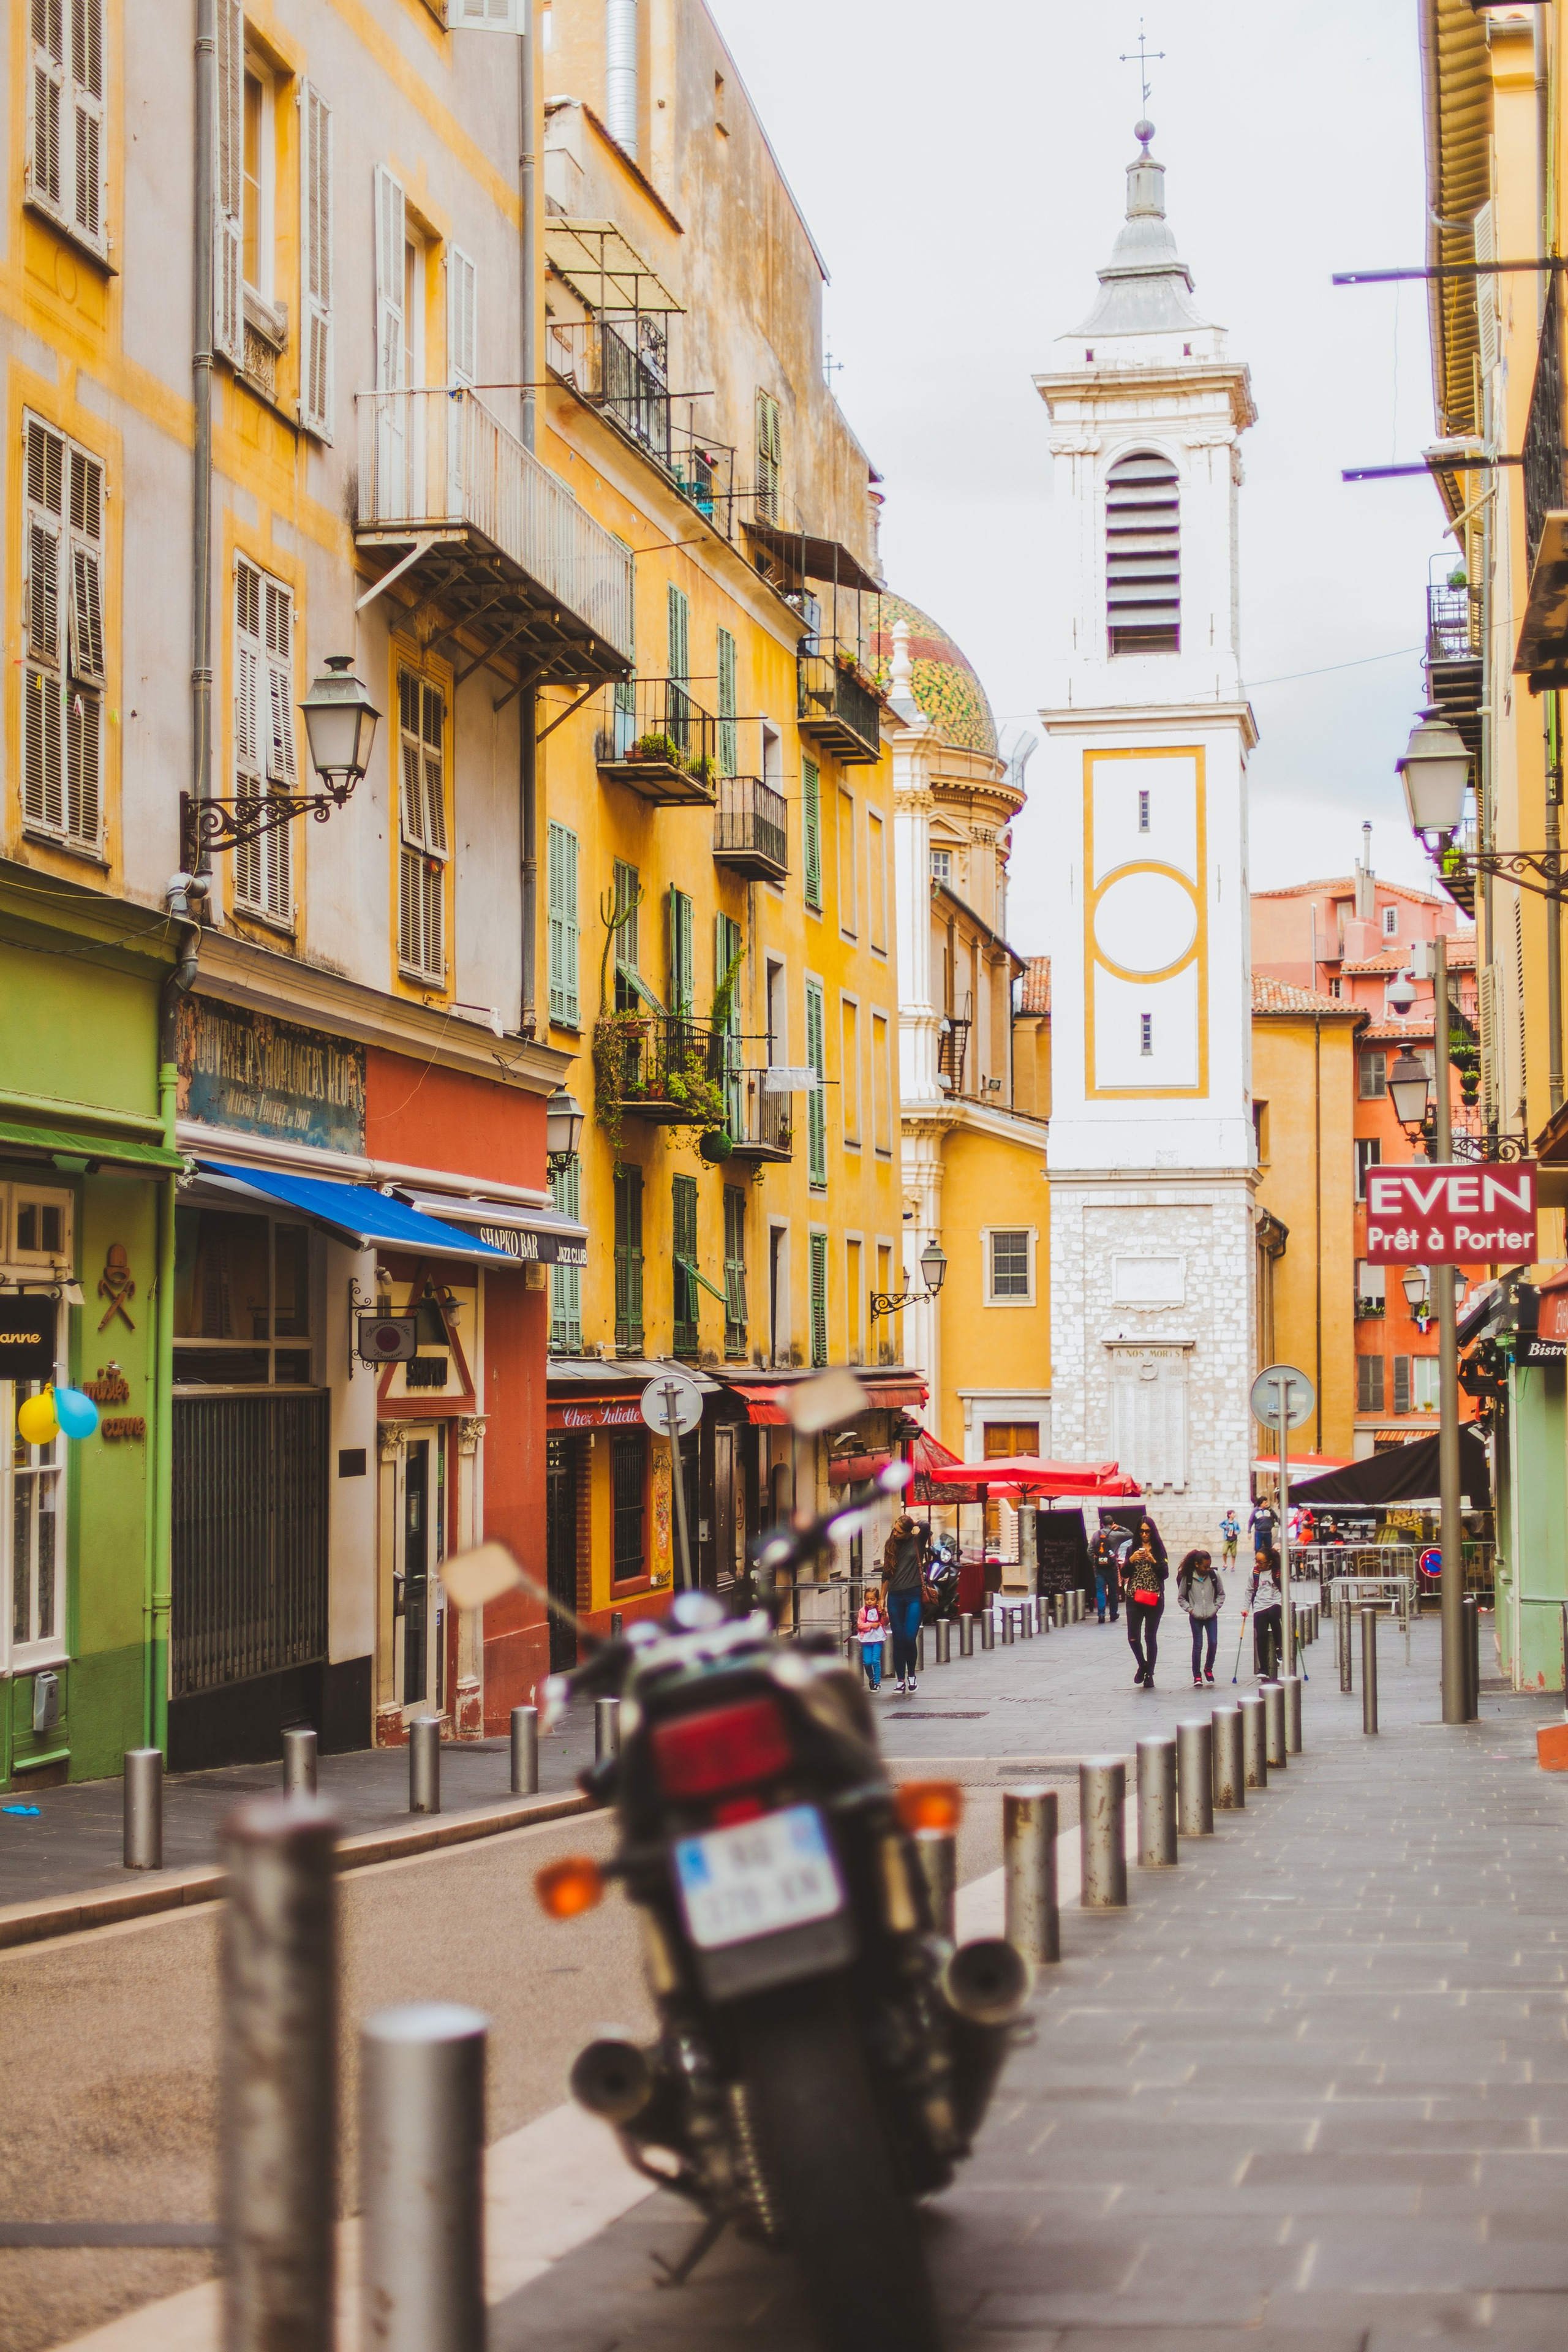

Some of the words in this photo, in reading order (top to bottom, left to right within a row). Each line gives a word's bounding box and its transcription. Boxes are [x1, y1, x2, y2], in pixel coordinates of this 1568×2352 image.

[265, 1029, 325, 1099] HORLOGERS
[1371, 1174, 1530, 1215] EVEN
[480, 1227, 519, 1256] SHAPKO
[520, 1232, 539, 1259] BAR
[1368, 1227, 1419, 1250] Prêt
[1428, 1227, 1444, 1250] à
[1455, 1226, 1534, 1250] Porter
[557, 1246, 571, 1263] JAZZ
[571, 1248, 587, 1265] CLUB
[366, 1320, 411, 1338] Damoiselle
[373, 1349, 403, 1359] Bouton
[101, 1416, 146, 1438] canne
[563, 1405, 594, 1427] Chez
[597, 1406, 641, 1425] Juliette
